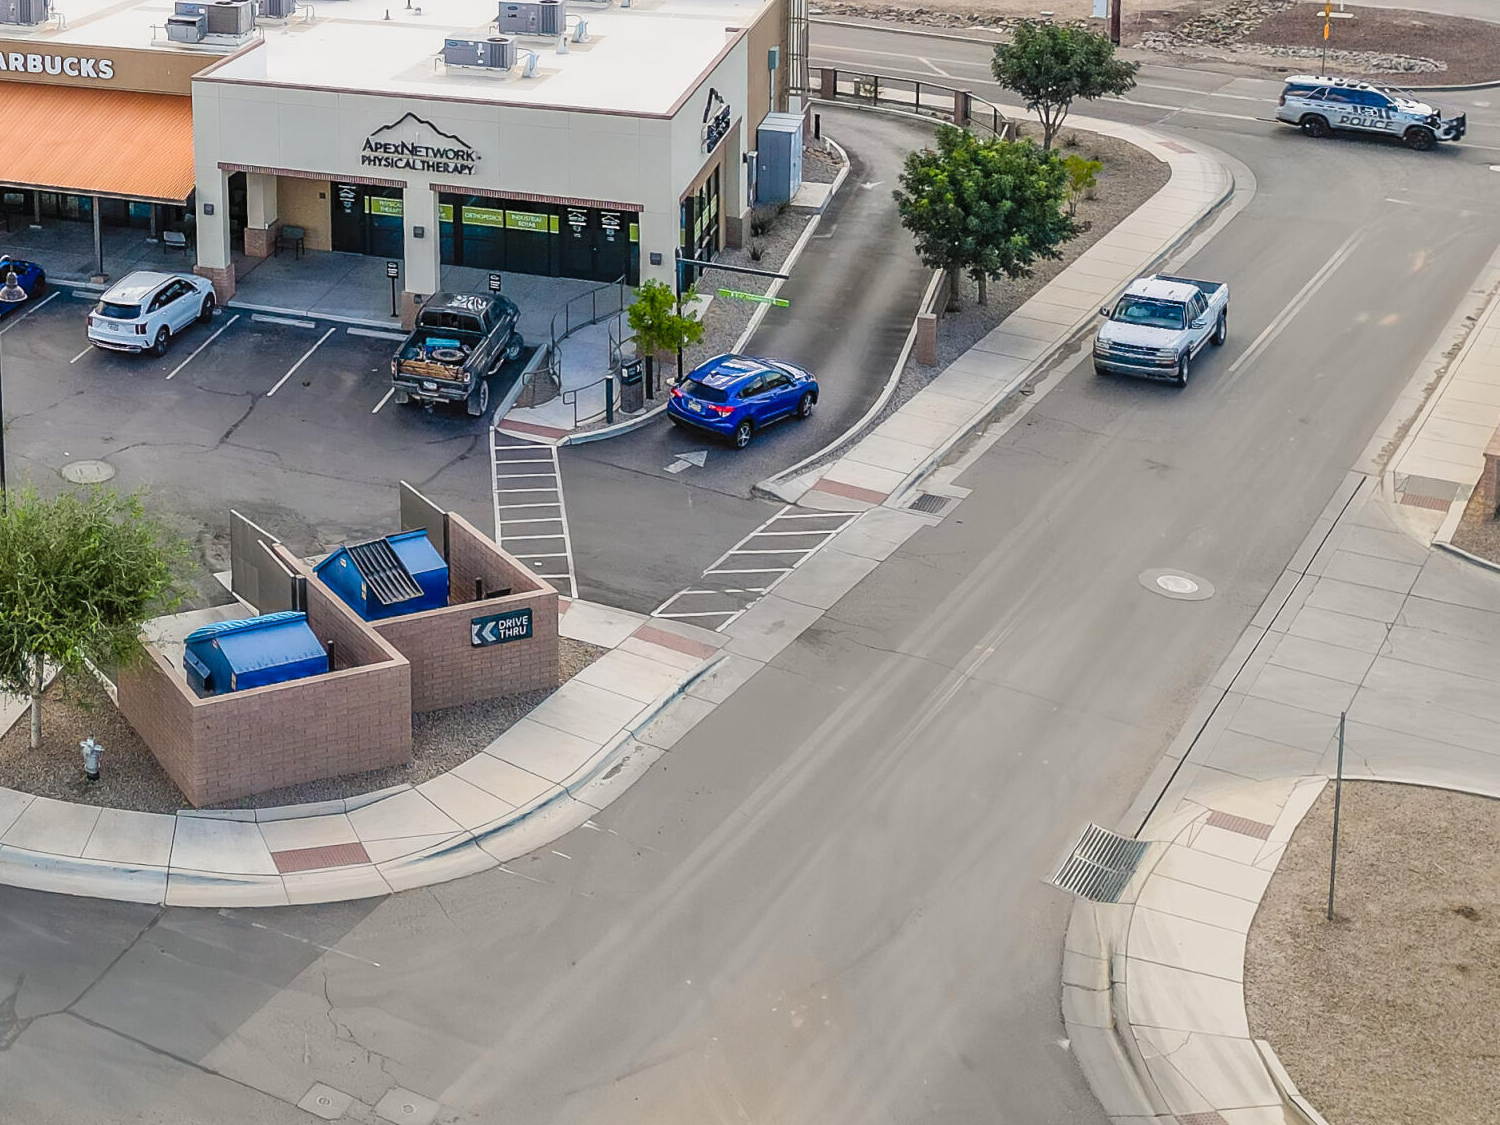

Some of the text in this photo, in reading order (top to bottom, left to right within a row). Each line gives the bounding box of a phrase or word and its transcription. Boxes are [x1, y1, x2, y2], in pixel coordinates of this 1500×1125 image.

[1340, 115, 1395, 131] POLICE
[361, 155, 476, 175] PHYSICAL THERAPY
[498, 615, 529, 629] DRIVE
[499, 625, 527, 639] THRU
